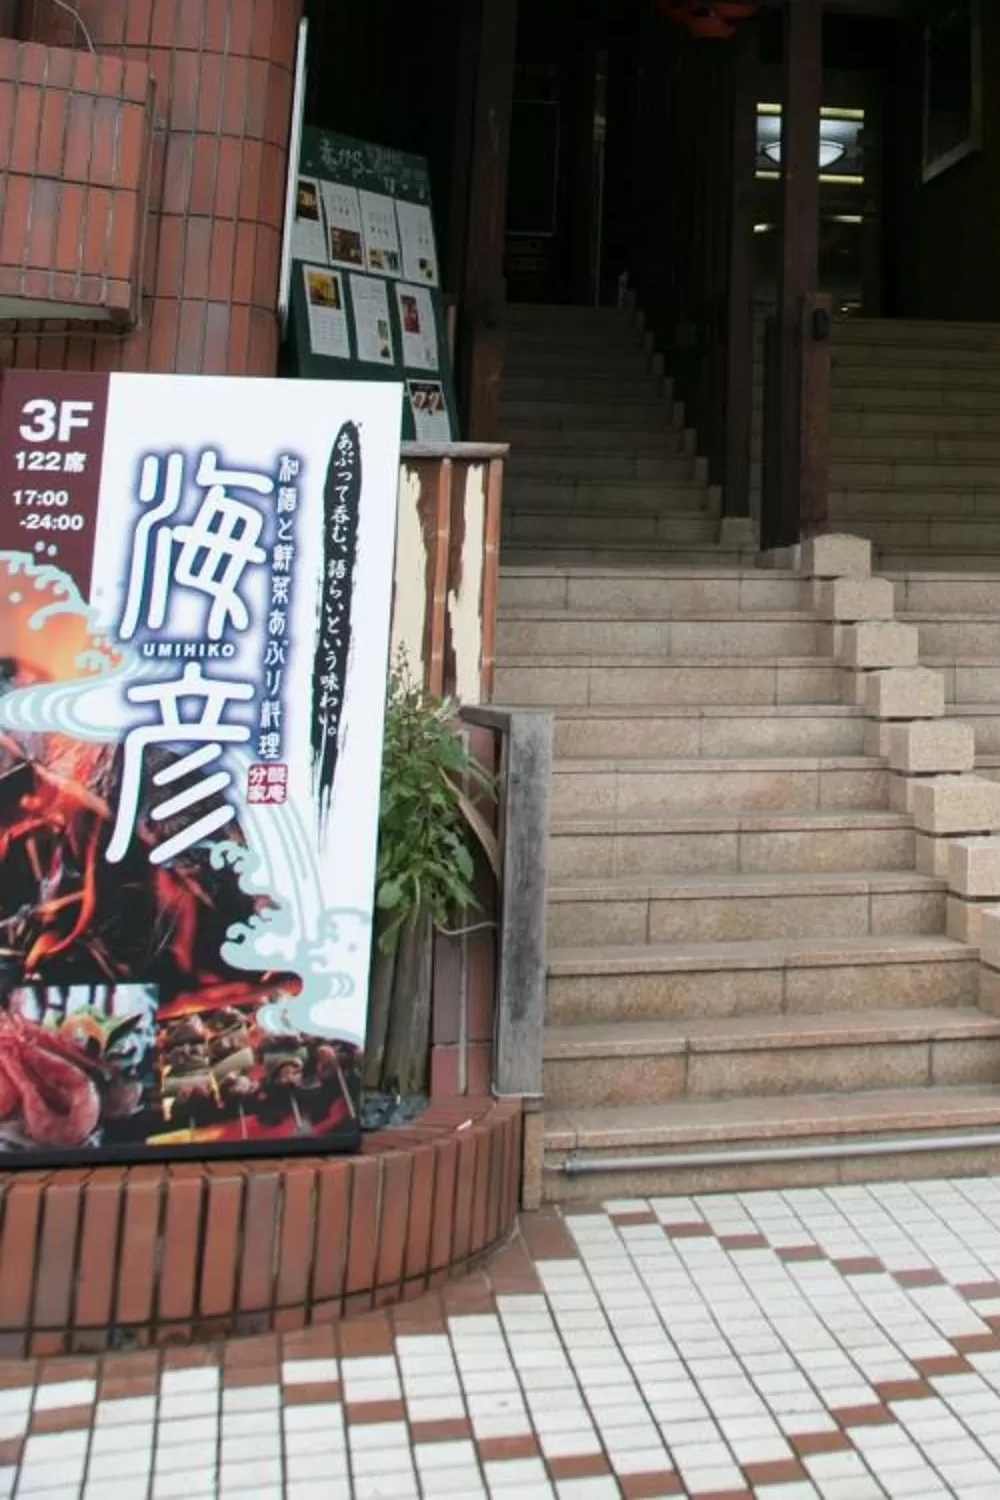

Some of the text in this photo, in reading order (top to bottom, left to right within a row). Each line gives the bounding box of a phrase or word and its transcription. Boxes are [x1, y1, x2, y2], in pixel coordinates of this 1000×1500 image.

[19, 399, 94, 443] 3F
[15, 451, 88, 473] 122席
[13, 489, 69, 507] 17:00
[20, 513, 85, 531] -24:00
[106, 450, 275, 865] 海彦
[143, 642, 236, 658] UMIHIKO
